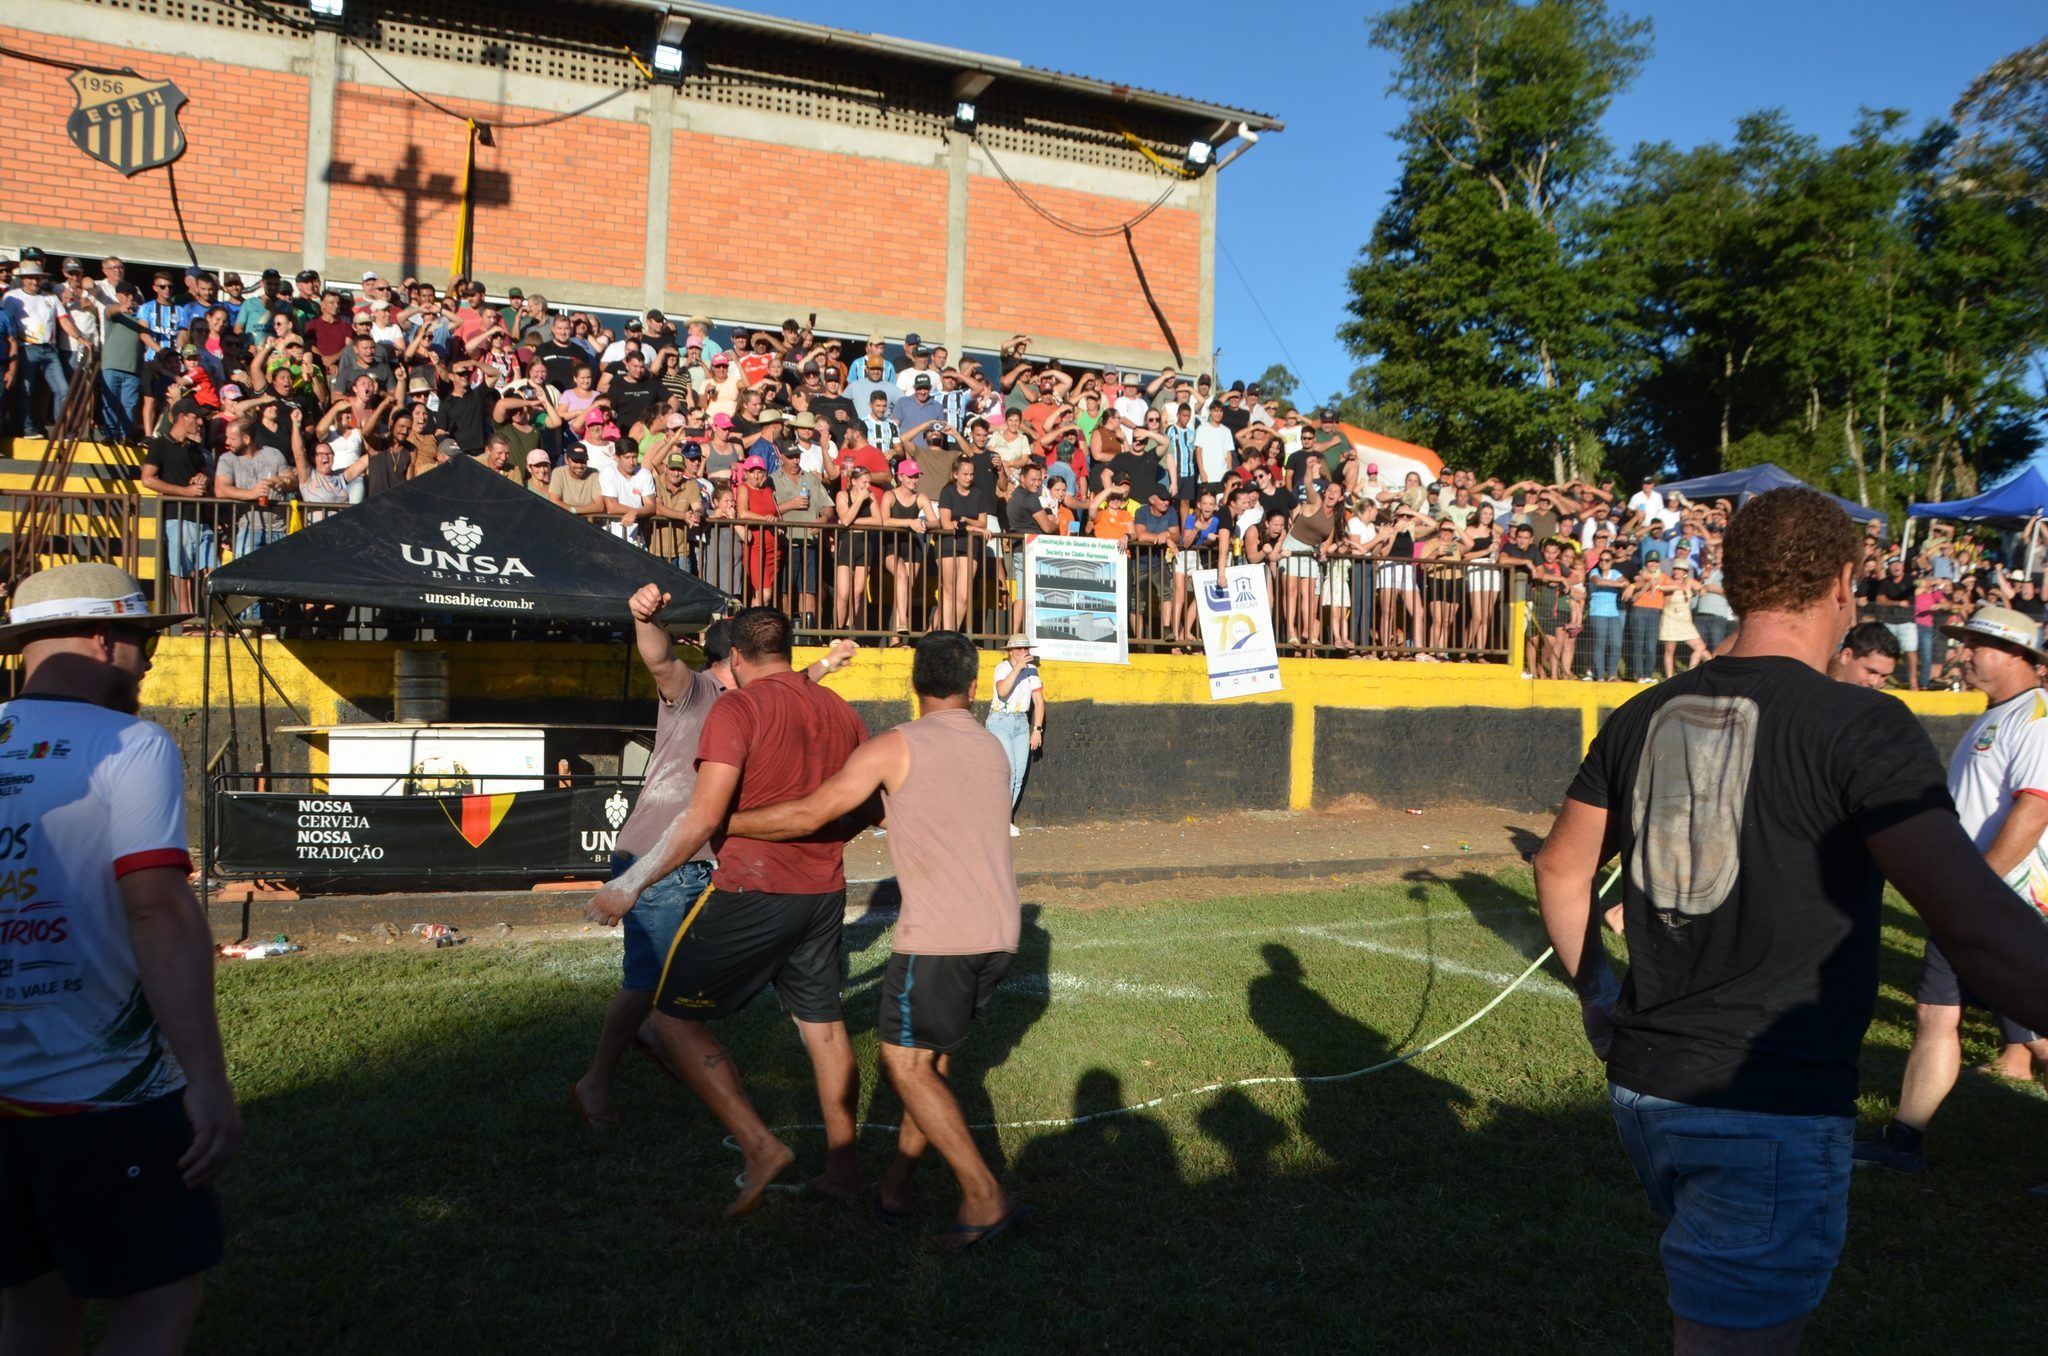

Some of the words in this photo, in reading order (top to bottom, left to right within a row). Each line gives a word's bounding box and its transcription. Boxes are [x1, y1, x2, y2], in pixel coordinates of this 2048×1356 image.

[79, 76, 124, 96] 1956
[399, 543, 536, 578] UNSA
[298, 799, 353, 814] NOSSA
[297, 814, 370, 830] CERVEJA
[0, 821, 33, 861] OS
[297, 829, 352, 845] NOSSA
[580, 830, 620, 852] UN
[296, 844, 384, 864] TRADIÇÃO
[0, 916, 68, 949] TRIOS
[20, 980, 59, 999] VALE
[63, 977, 83, 993] RS
